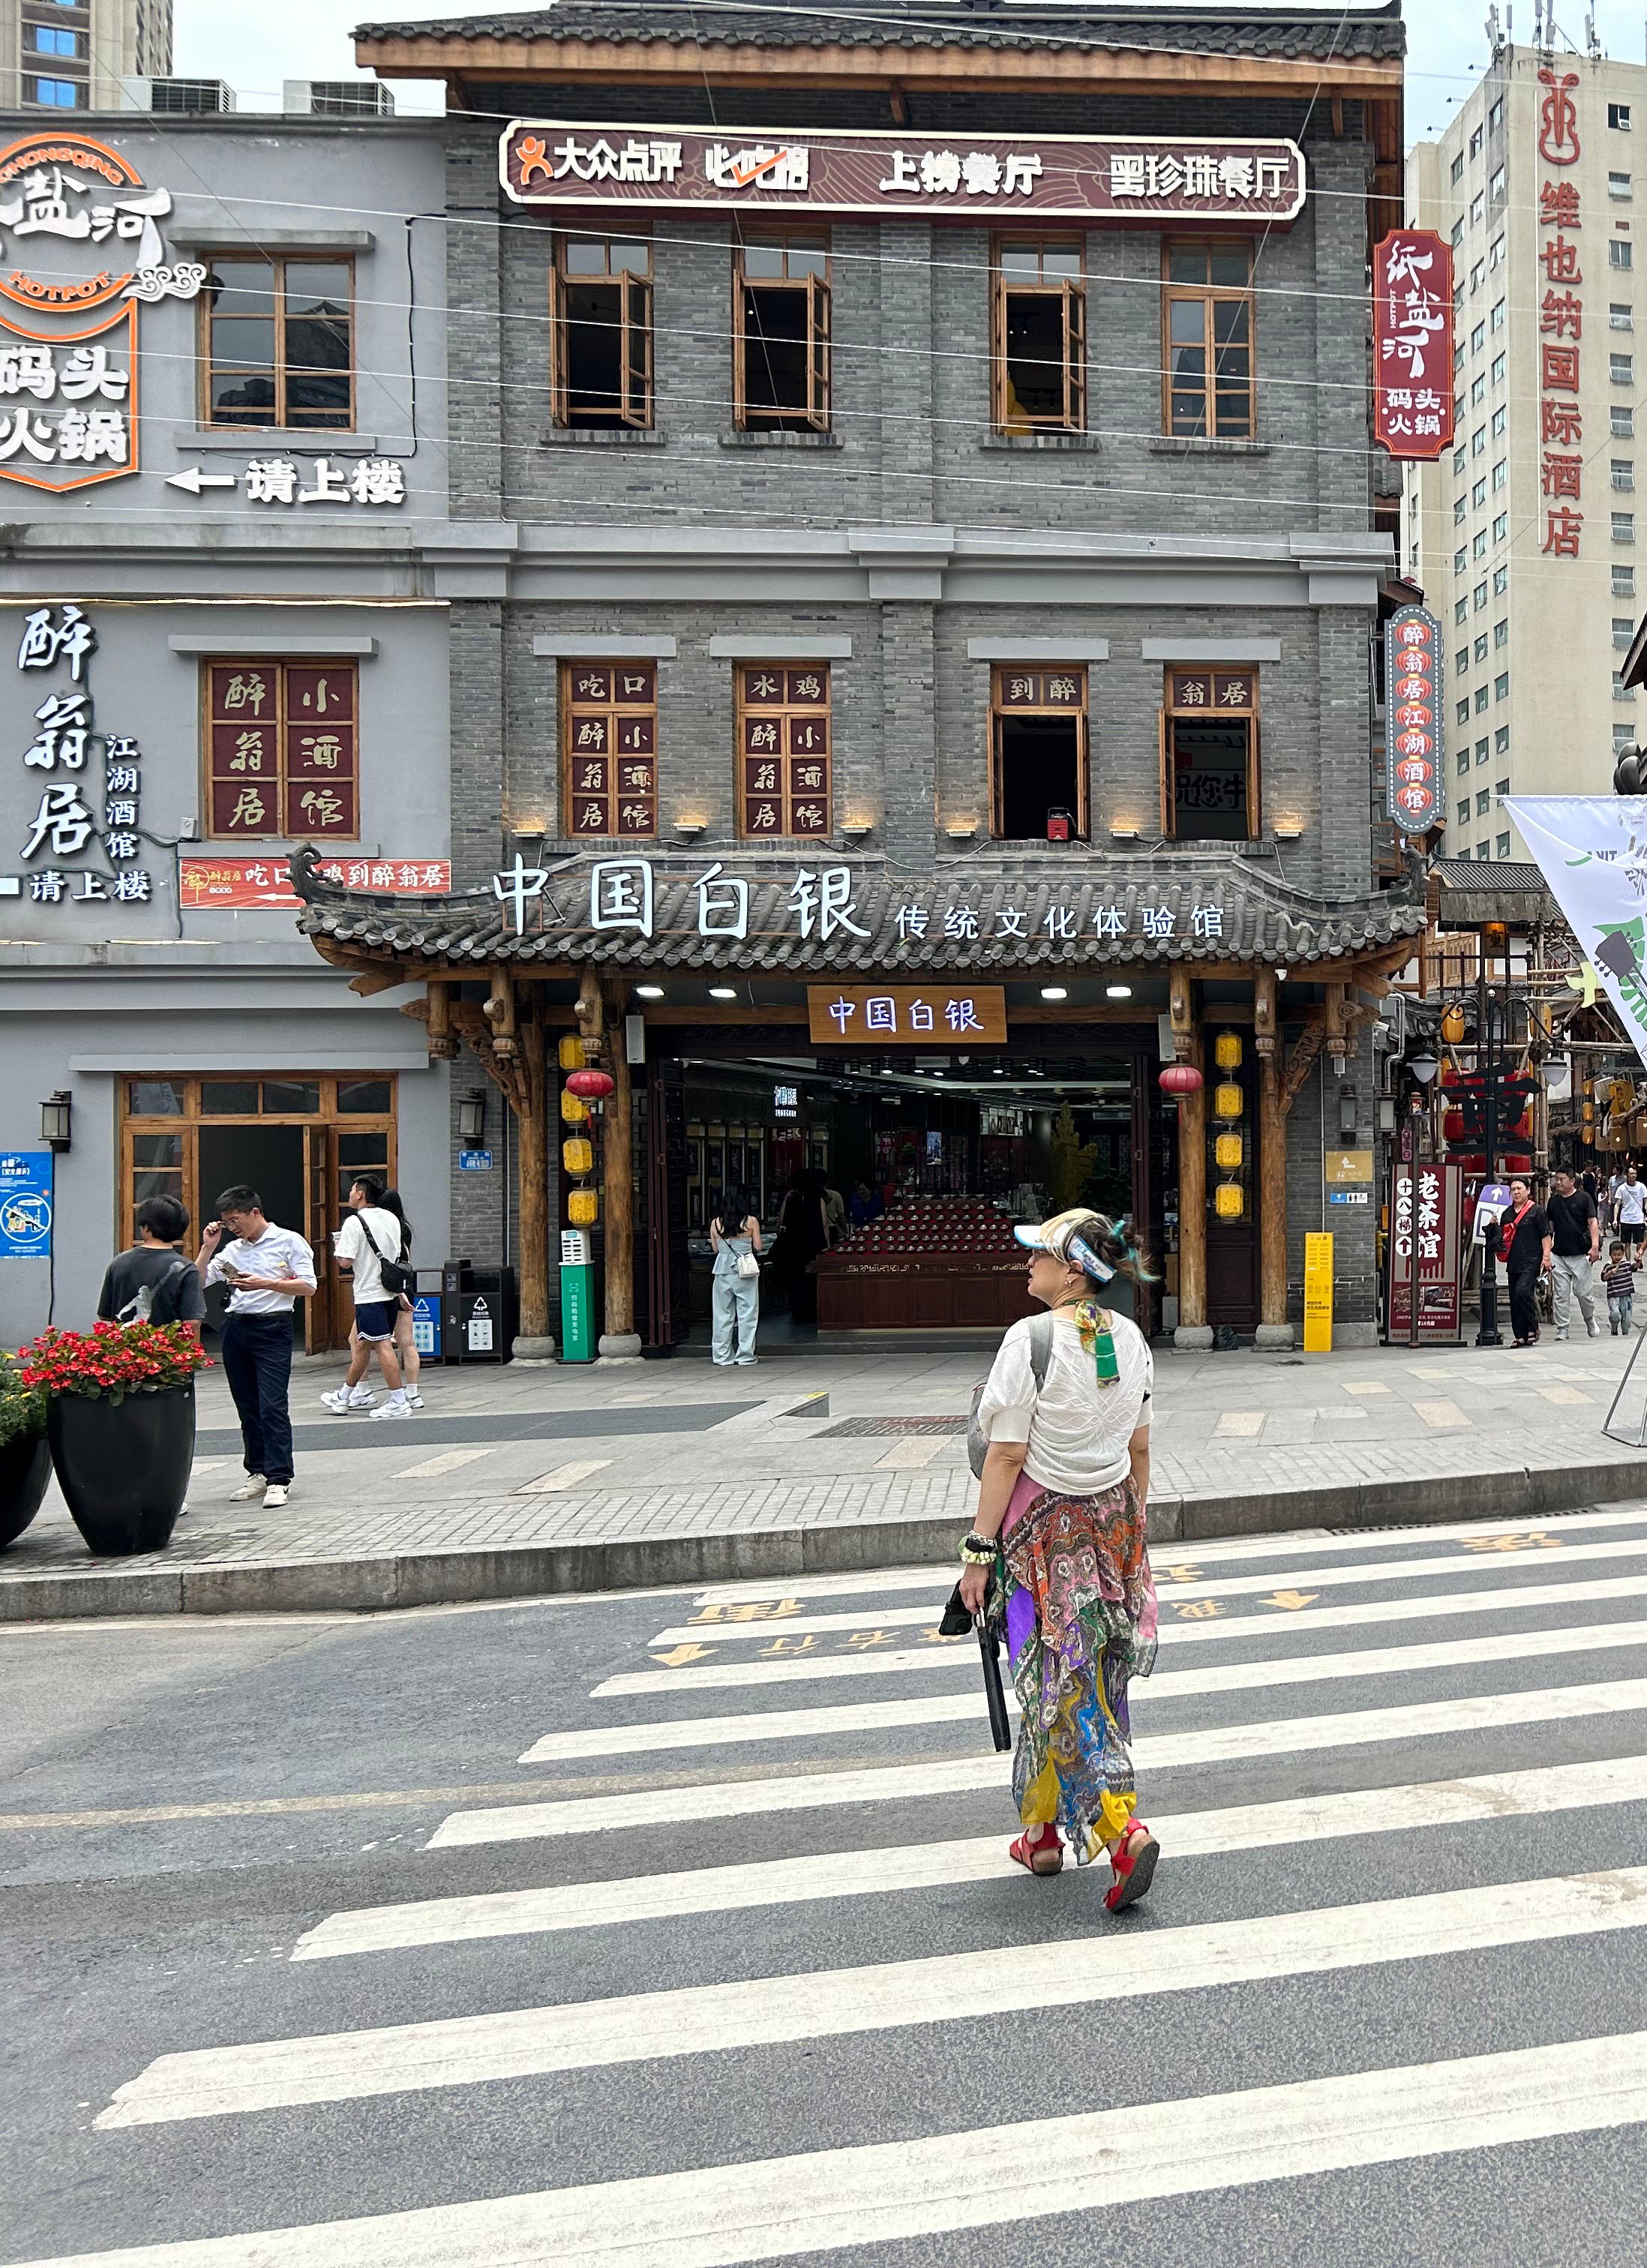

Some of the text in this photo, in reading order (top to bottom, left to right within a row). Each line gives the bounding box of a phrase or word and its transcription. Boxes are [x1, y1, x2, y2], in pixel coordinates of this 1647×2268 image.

[0, 148, 124, 187] CHONGQING
[554, 136, 683, 182] 大众点评
[878, 149, 1043, 196] 上榜餐厅
[1110, 154, 1289, 199] 黑珍珠餐厅
[0, 166, 171, 268] 盐河
[9, 271, 110, 302] HOTPOT
[1382, 240, 1445, 379] 纸盐河
[0, 345, 130, 400] 码头
[1539, 180, 1584, 558] 维也纳国际酒店
[1387, 387, 1441, 410] 码头
[1388, 412, 1441, 436] 火锅
[245, 458, 406, 504] 请上楼
[578, 674, 646, 698] 吃口
[750, 674, 820, 699] 水鸡
[1009, 676, 1078, 702] 到醉
[1180, 680, 1248, 705] 翁居
[17, 604, 94, 860] 醉翁居
[1402, 626, 1426, 809] 醉翁居江湖酒馆
[224, 673, 266, 828] 醉翁居
[300, 678, 344, 826] 小酒馆
[578, 722, 604, 828] 醉翁居
[105, 734, 140, 860] 江湖酒馆
[622, 725, 651, 829] 小酒馆
[750, 724, 776, 829] 醉翁居
[796, 725, 824, 829] 小酒馆
[29, 871, 151, 902] 请上楼
[244, 863, 445, 888] 吃口鸡到醉翁居
[492, 852, 872, 941] 中国白银
[894, 904, 1225, 940] 传统文化体验馆
[829, 995, 985, 1034] 中国白银
[1397, 1179, 1412, 1232] 十八梯
[1418, 1170, 1442, 1258] 老茶馆
